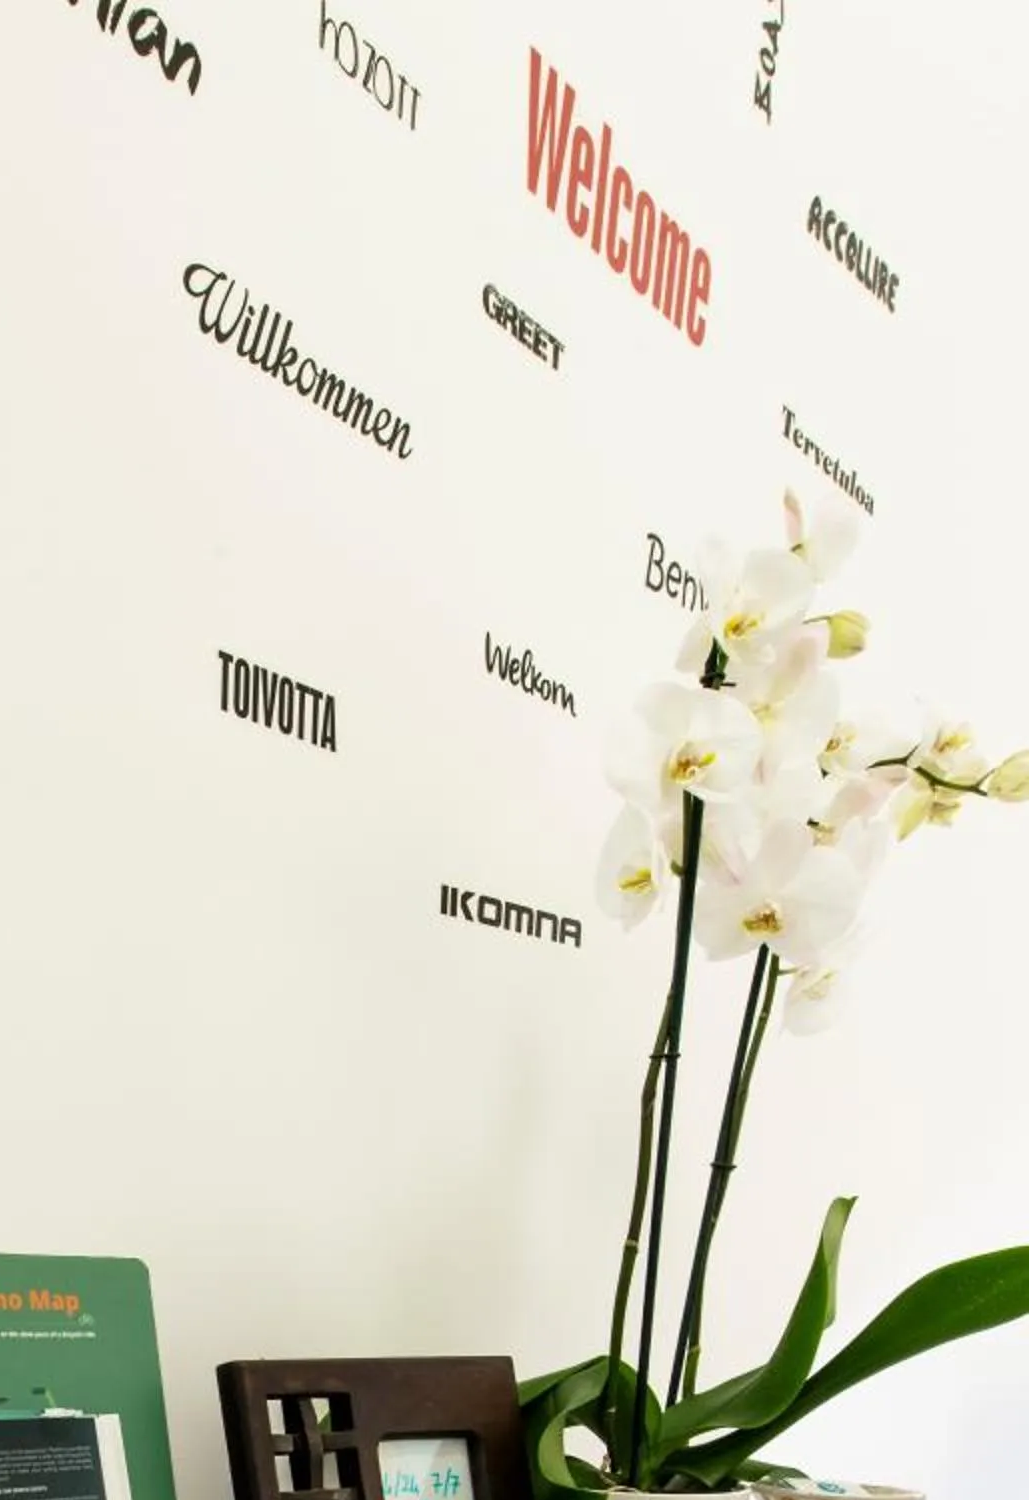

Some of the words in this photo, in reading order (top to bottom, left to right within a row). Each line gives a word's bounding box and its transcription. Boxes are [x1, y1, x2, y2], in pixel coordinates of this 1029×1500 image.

[526, 45, 712, 347] Welcome
[183, 262, 413, 460] Willkommen
[482, 283, 566, 371] GREET
[782, 404, 875, 517] Tervetuloa
[218, 649, 337, 753] TOIVOTTA
[484, 631, 577, 717] Welkom
[29, 1288, 80, 1318] Map
